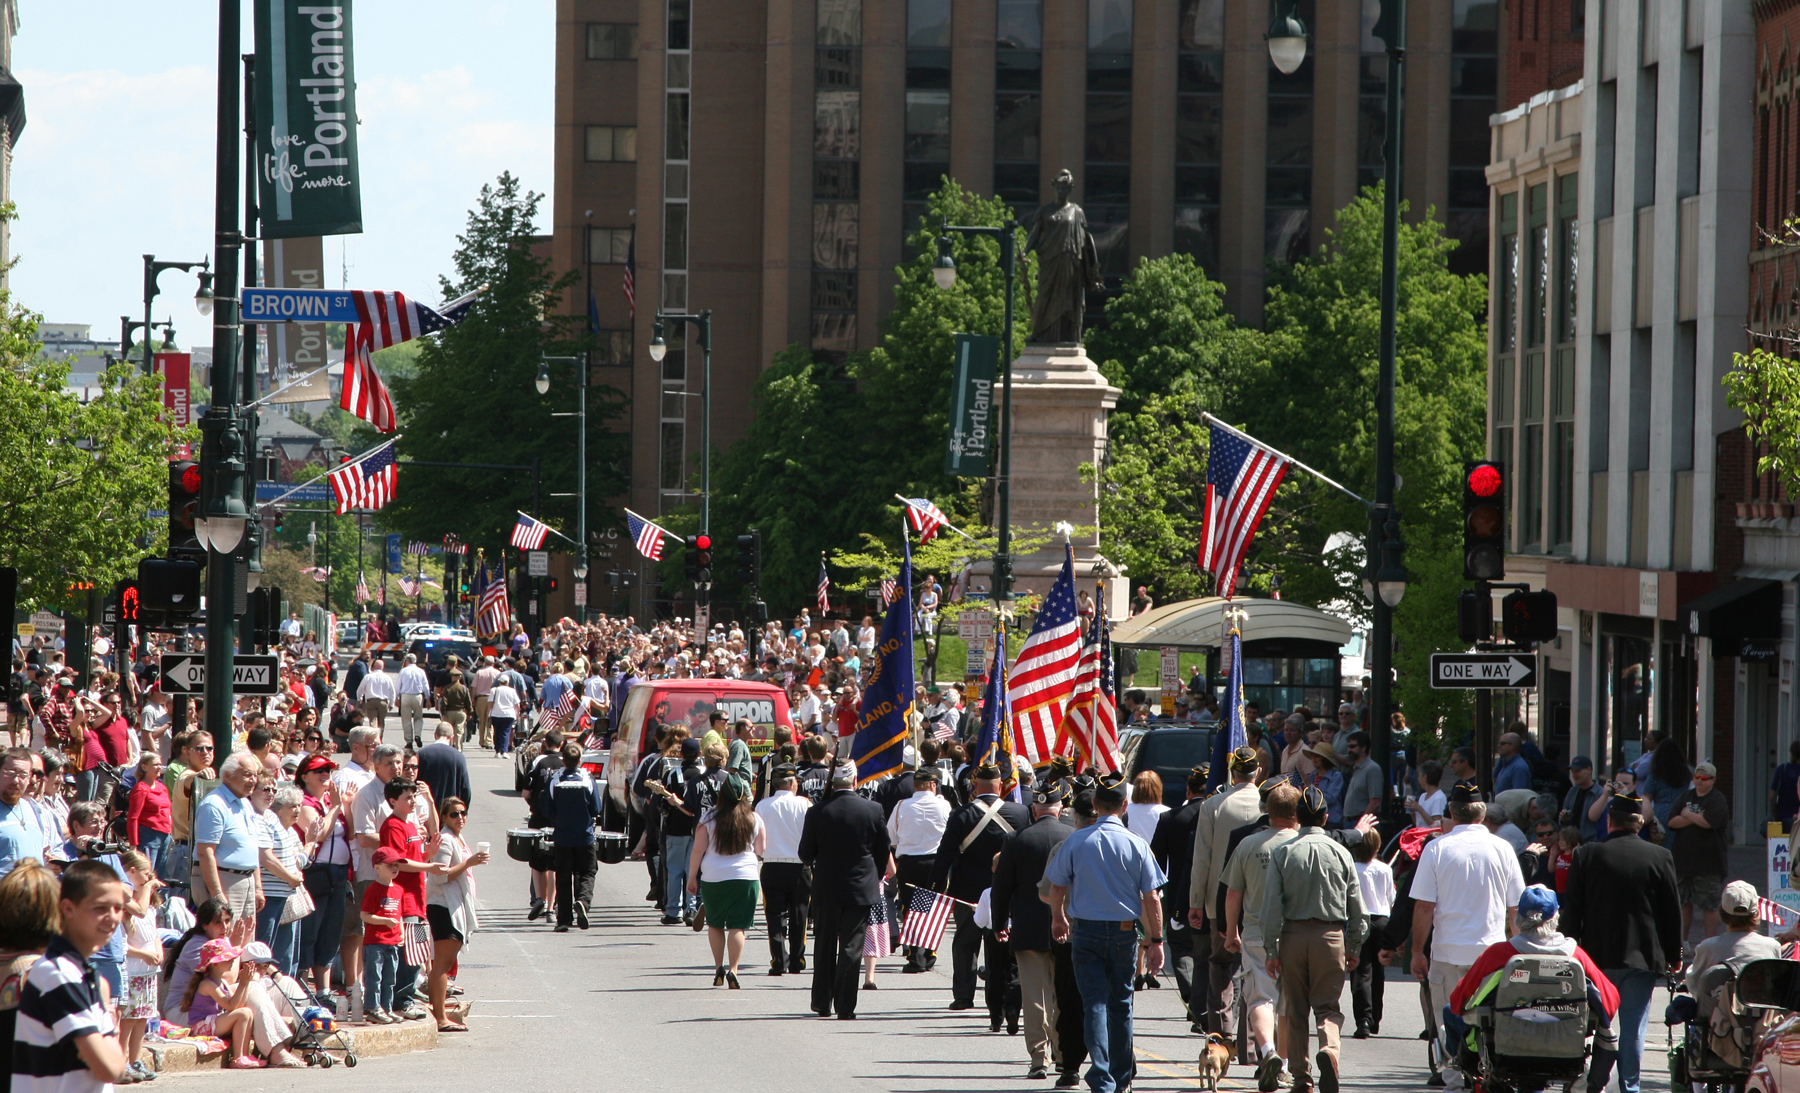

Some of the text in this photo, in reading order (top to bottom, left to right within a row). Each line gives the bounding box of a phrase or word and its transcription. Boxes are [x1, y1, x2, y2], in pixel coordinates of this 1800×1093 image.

[298, 6, 349, 167] Portland
[271, 125, 306, 151] love.
[264, 152, 308, 193] life.
[301, 175, 352, 189] more.
[251, 295, 348, 317] BROWN ST
[967, 378, 991, 449] Portland
[879, 638, 904, 656] NO.
[1164, 658, 1175, 666] BUS
[1443, 665, 1513, 678] ONE WAY
[233, 668, 267, 682] WAY
[716, 701, 773, 724] WPOR
[1532, 1004, 1549, 1013] mith
